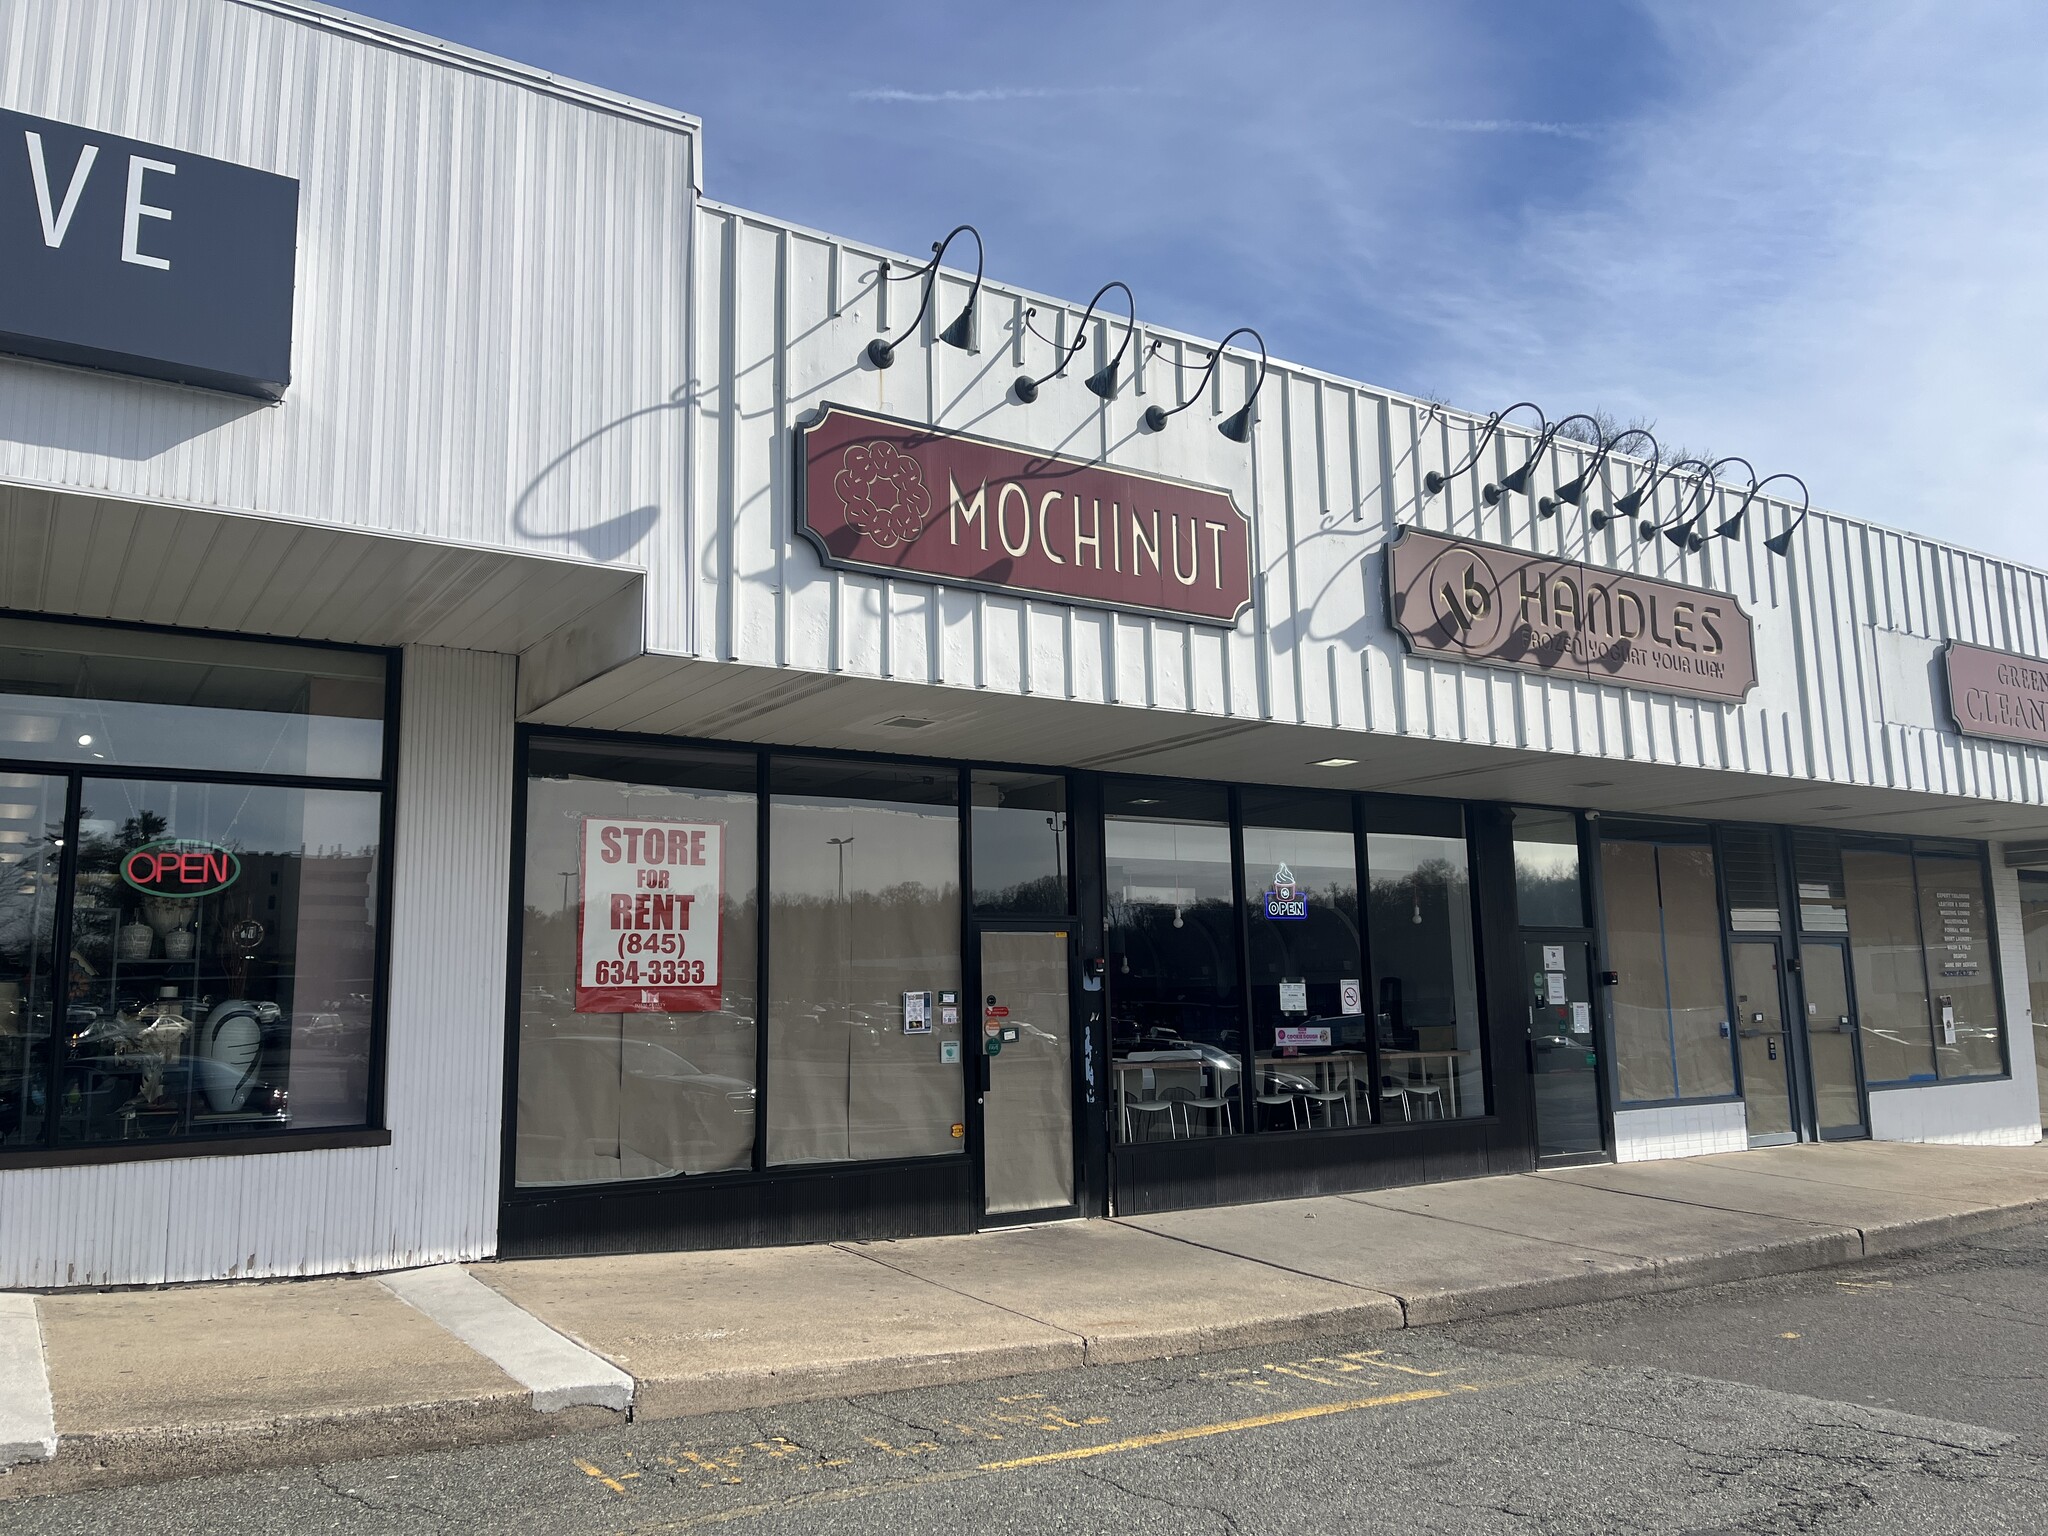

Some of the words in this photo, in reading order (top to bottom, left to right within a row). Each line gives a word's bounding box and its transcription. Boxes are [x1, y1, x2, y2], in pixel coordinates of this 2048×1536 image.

[948, 467, 1228, 590] MOCHINUT
[1440, 562, 1492, 633] 16
[1519, 568, 1724, 656] HANDLES
[1521, 630, 1583, 657] FROZEN
[1588, 639, 1648, 667] YOGURT
[1652, 651, 1692, 673] YOUR
[1695, 659, 1726, 679] WAY
[601, 826, 706, 866] STORE
[127, 852, 229, 884] OPEN
[637, 869, 670, 889] FOR
[610, 893, 695, 931] RENT
[1268, 901, 1304, 916] OPEN
[617, 932, 686, 960] (845)
[595, 960, 705, 985] 634-3333
